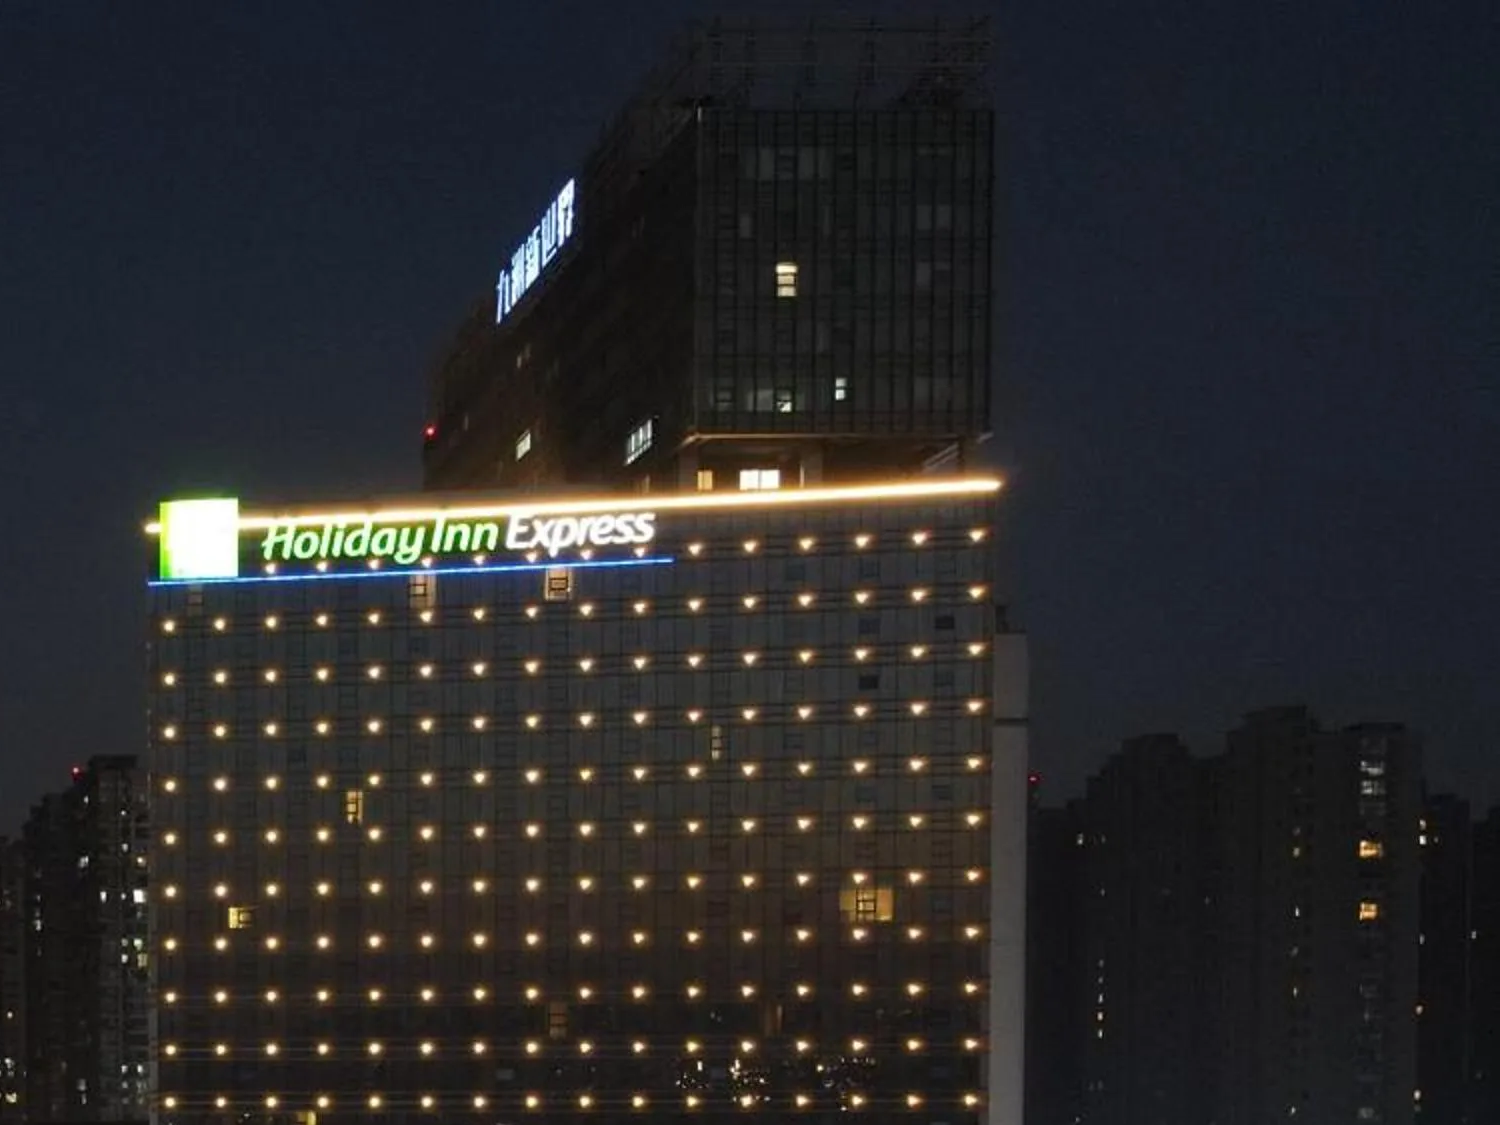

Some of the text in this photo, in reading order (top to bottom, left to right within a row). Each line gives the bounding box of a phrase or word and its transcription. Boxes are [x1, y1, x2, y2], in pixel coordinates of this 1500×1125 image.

[262, 511, 656, 564] Holiday Inn Express
